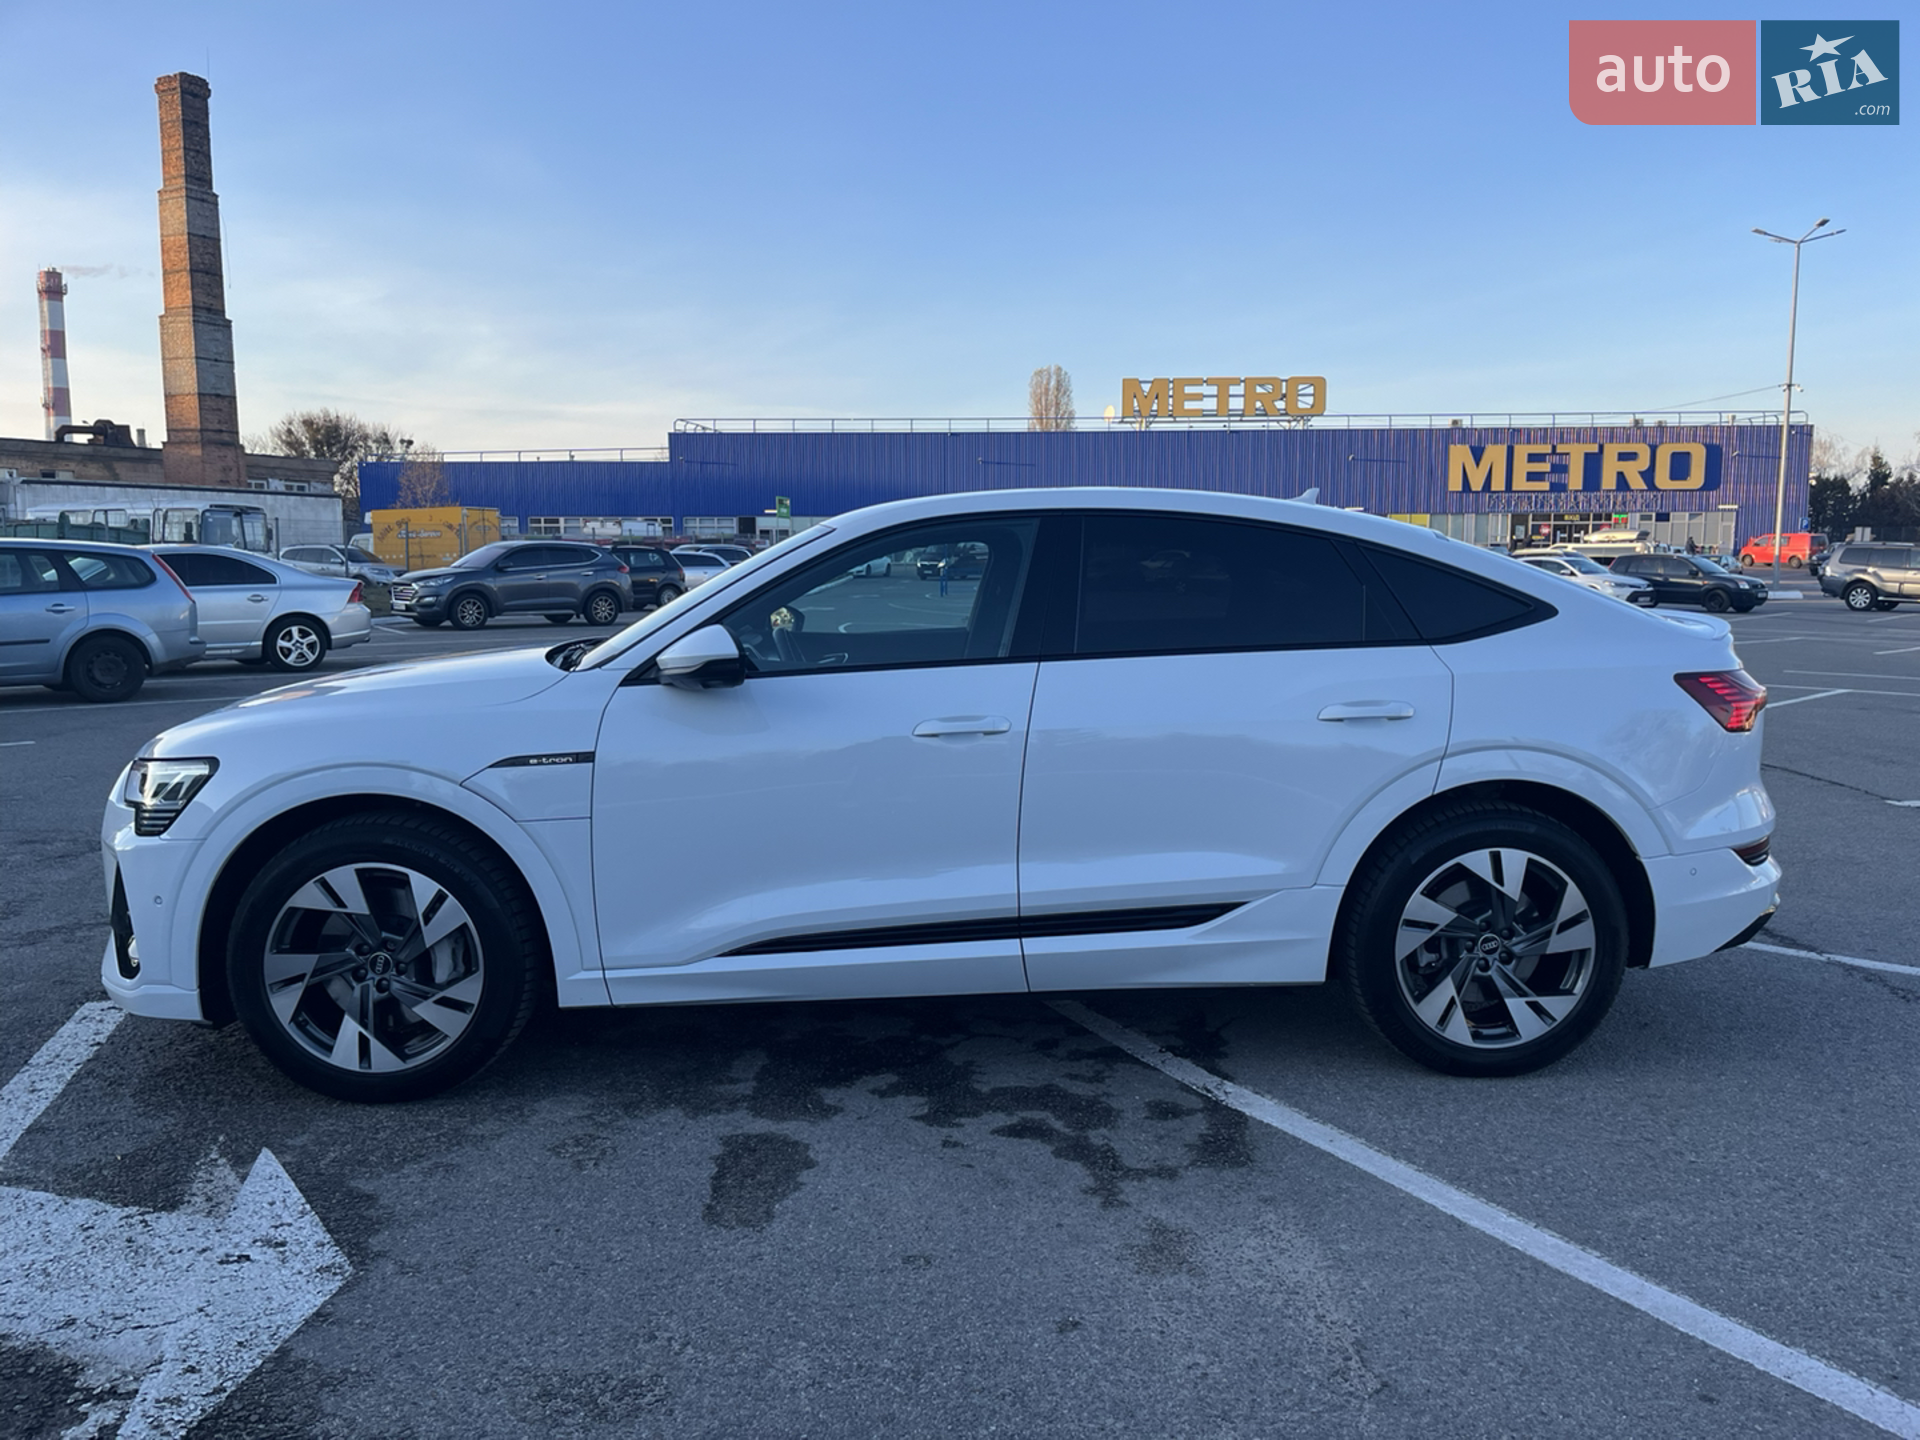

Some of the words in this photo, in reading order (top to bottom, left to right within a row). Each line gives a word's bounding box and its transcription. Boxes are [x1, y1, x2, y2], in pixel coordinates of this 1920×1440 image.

[1122, 376, 1326, 417] METRO
[1448, 443, 1707, 492] METRO
[529, 756, 573, 764] e-tron
